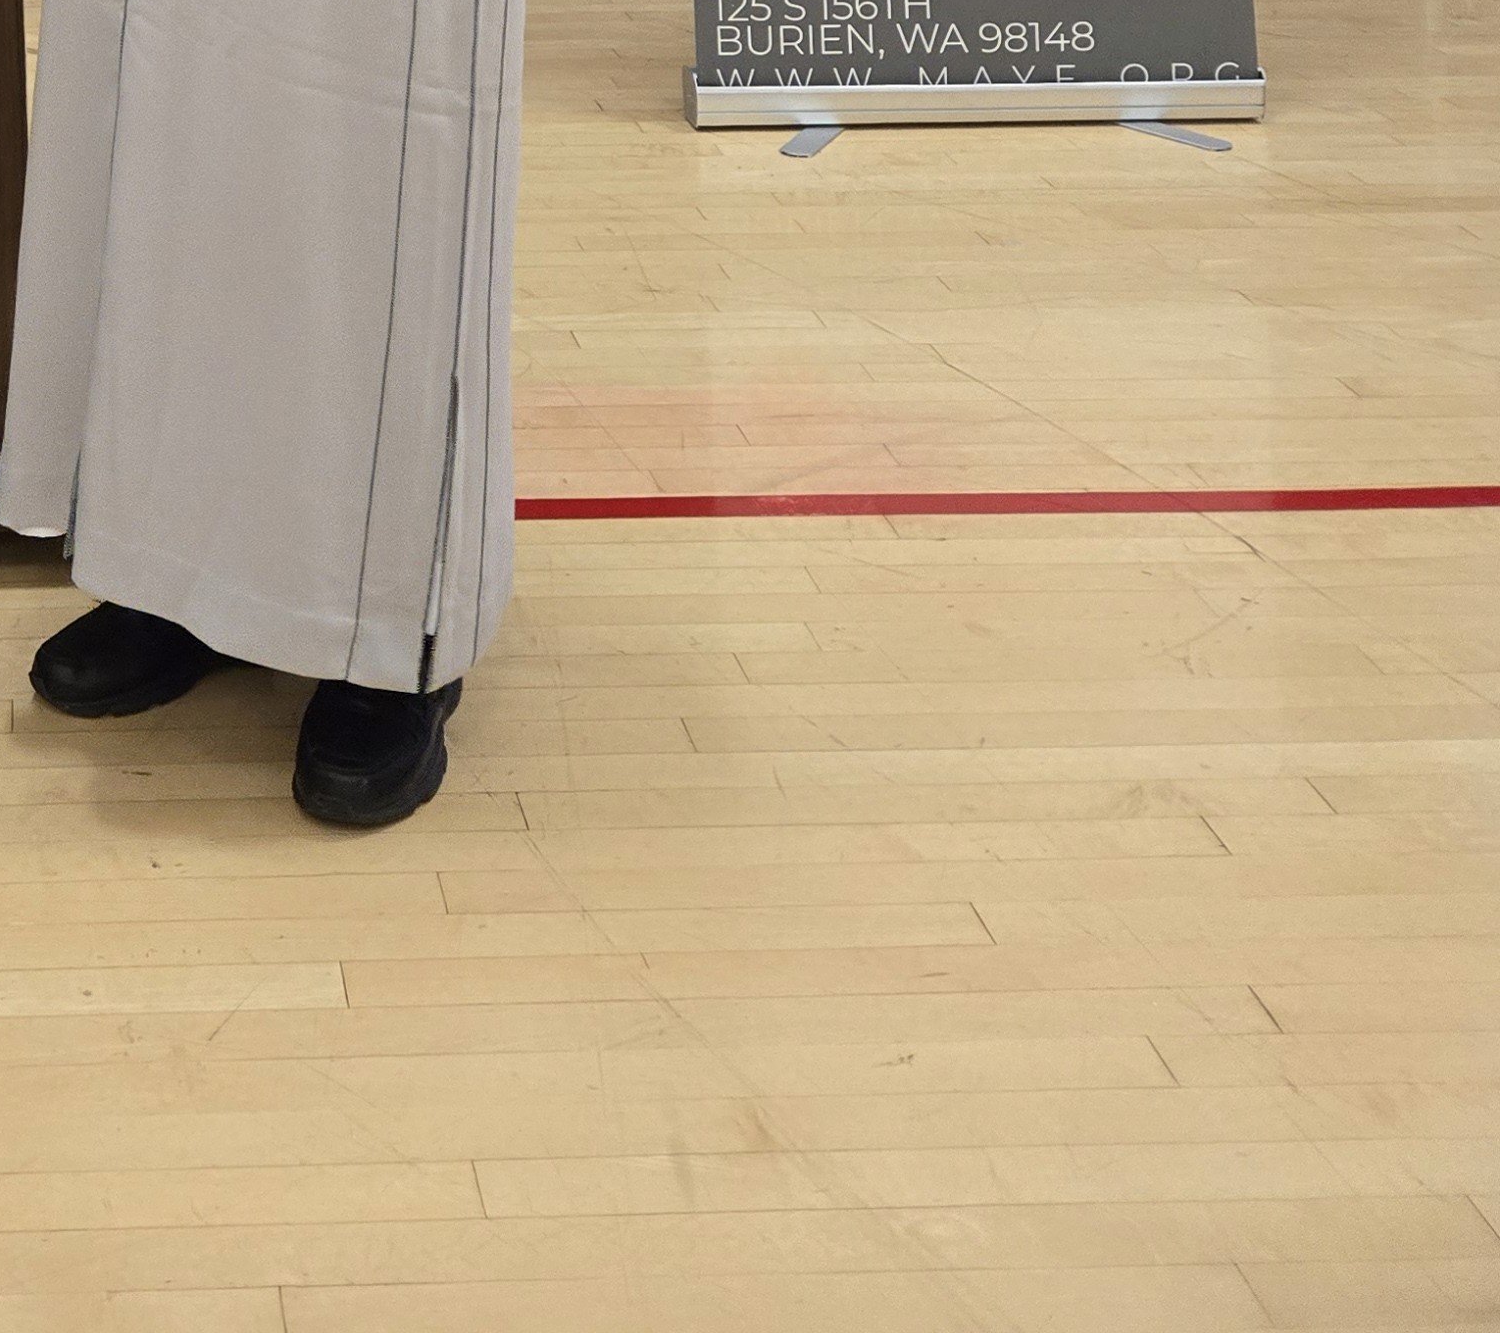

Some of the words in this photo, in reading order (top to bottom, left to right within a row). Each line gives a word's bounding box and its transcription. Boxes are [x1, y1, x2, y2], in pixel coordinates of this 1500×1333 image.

[716, 23, 884, 59] BURIEN,
[895, 23, 969, 53] WA
[978, 20, 1094, 53] 98148
